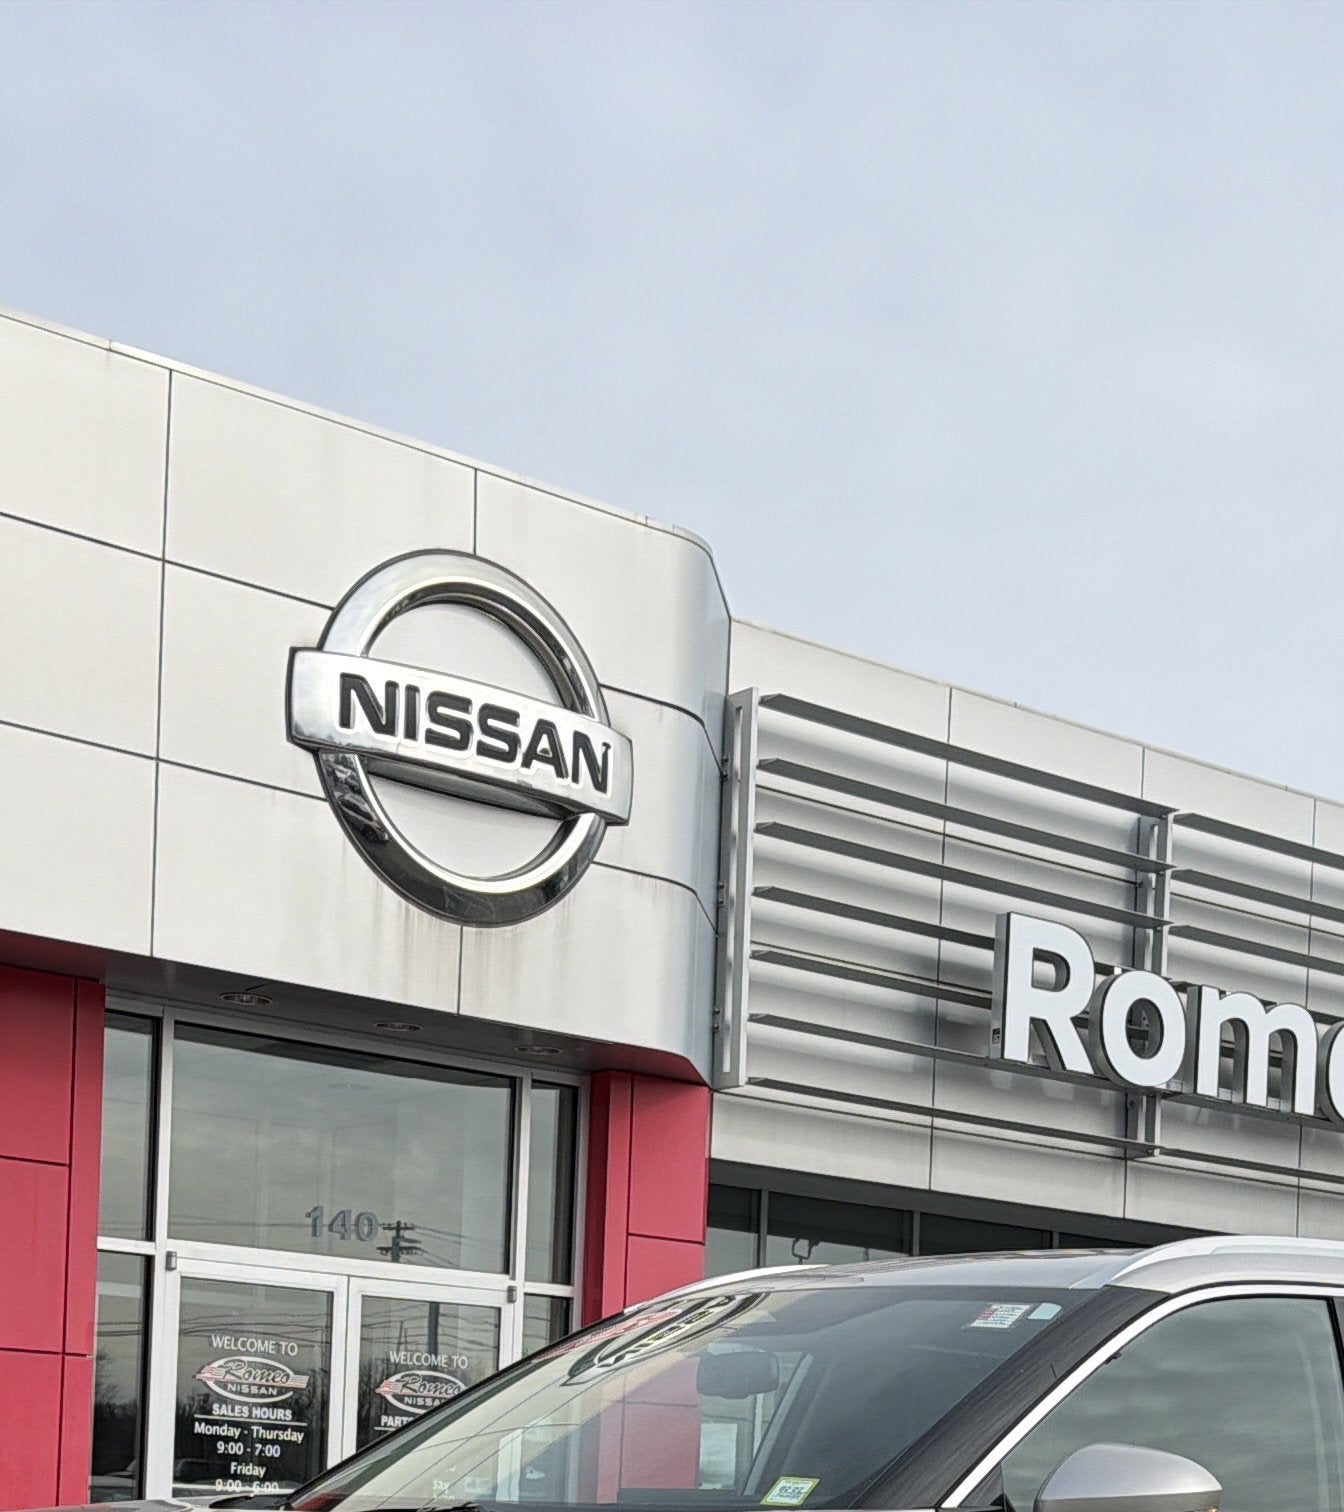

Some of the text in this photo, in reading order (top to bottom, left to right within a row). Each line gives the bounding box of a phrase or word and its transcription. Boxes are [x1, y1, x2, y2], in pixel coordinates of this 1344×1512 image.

[338, 671, 613, 796] NISSAN
[305, 1205, 379, 1242] 140
[212, 1335, 298, 1356] WELCOME TO
[389, 1351, 468, 1369] WELCOME TO
[217, 1358, 291, 1384] Romeo
[227, 1383, 278, 1396] NISSAN
[404, 1396, 448, 1407] NISSA
[212, 1403, 292, 1421] SALES HOURS
[194, 1421, 241, 1439] Monday
[251, 1426, 305, 1444] Thursday
[217, 1441, 244, 1455] 9:00
[254, 1444, 281, 1457] 7:00
[230, 1462, 266, 1478] Friday
[215, 1479, 242, 1492] 9:00
